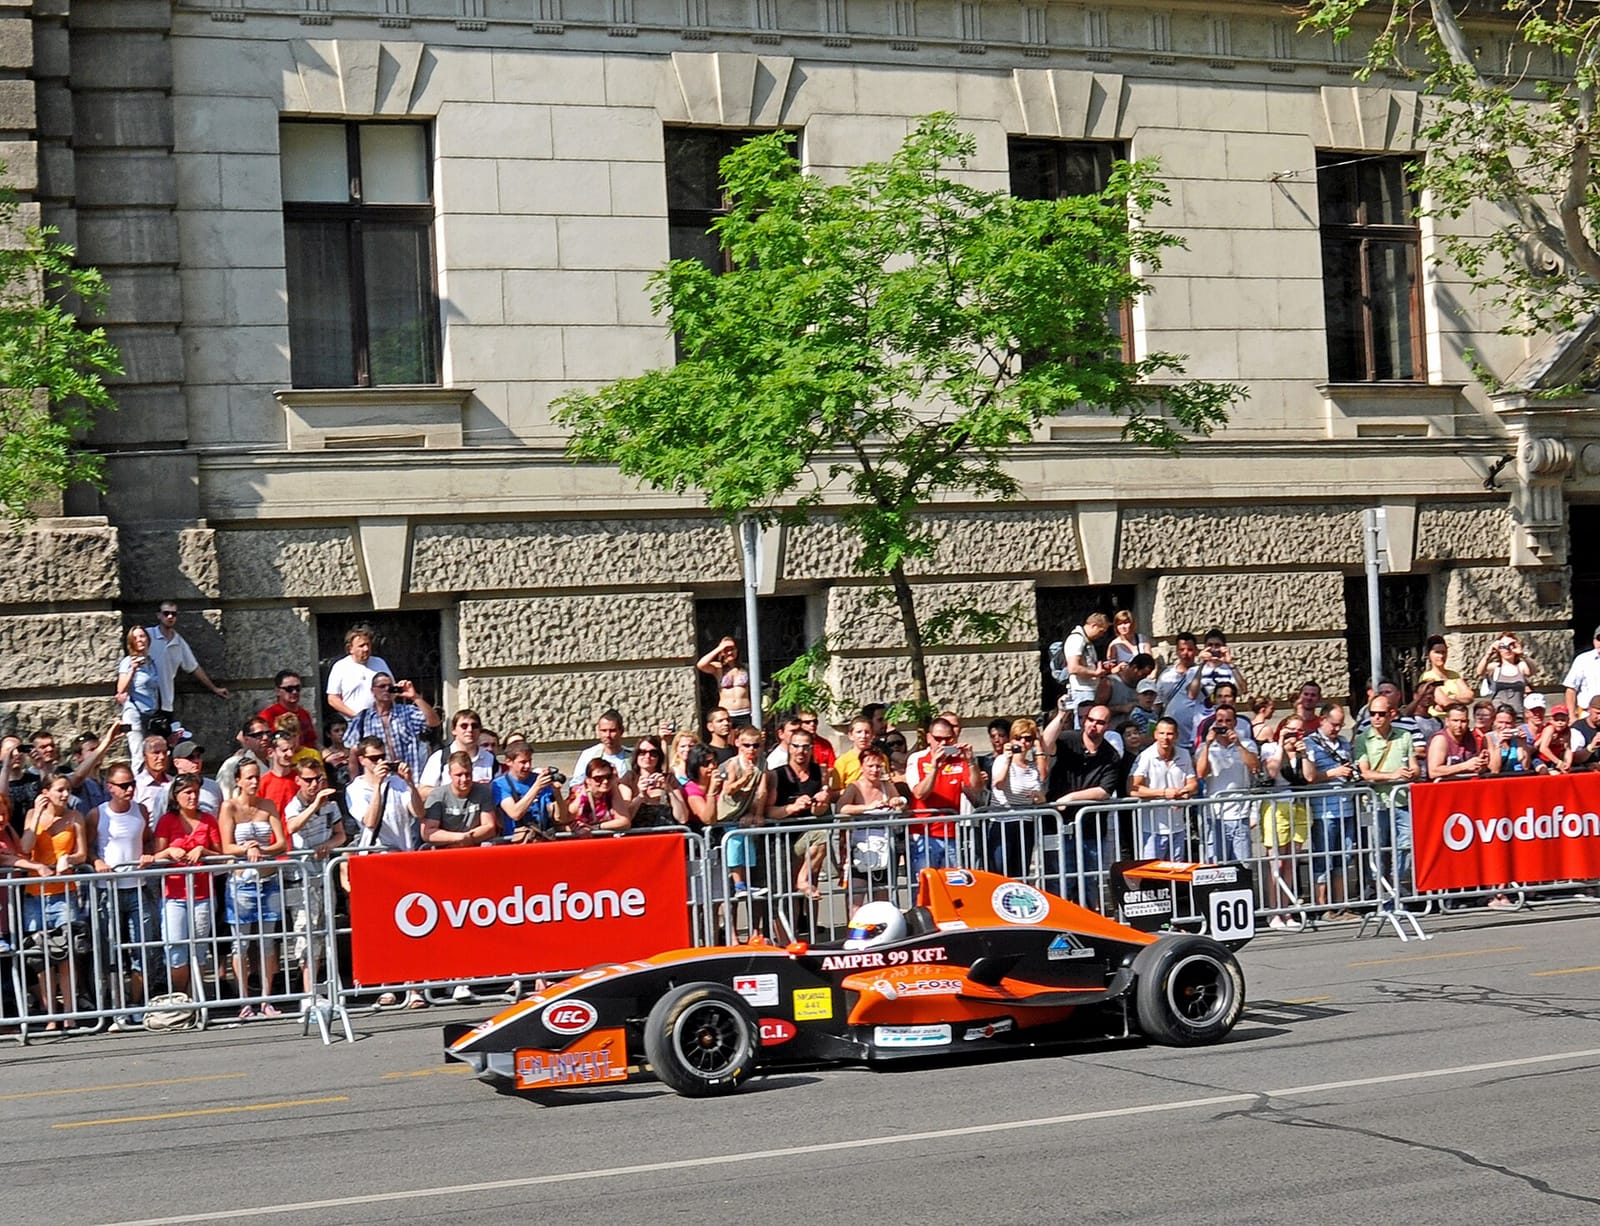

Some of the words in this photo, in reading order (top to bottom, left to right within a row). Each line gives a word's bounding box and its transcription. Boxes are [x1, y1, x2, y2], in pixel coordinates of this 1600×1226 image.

[441, 882, 646, 928] vodafone
[1216, 898, 1248, 932] 60
[821, 952, 886, 971] AMPER
[888, 951, 909, 965] 99
[911, 947, 948, 963] KFT.
[553, 1010, 586, 1024] IEC
